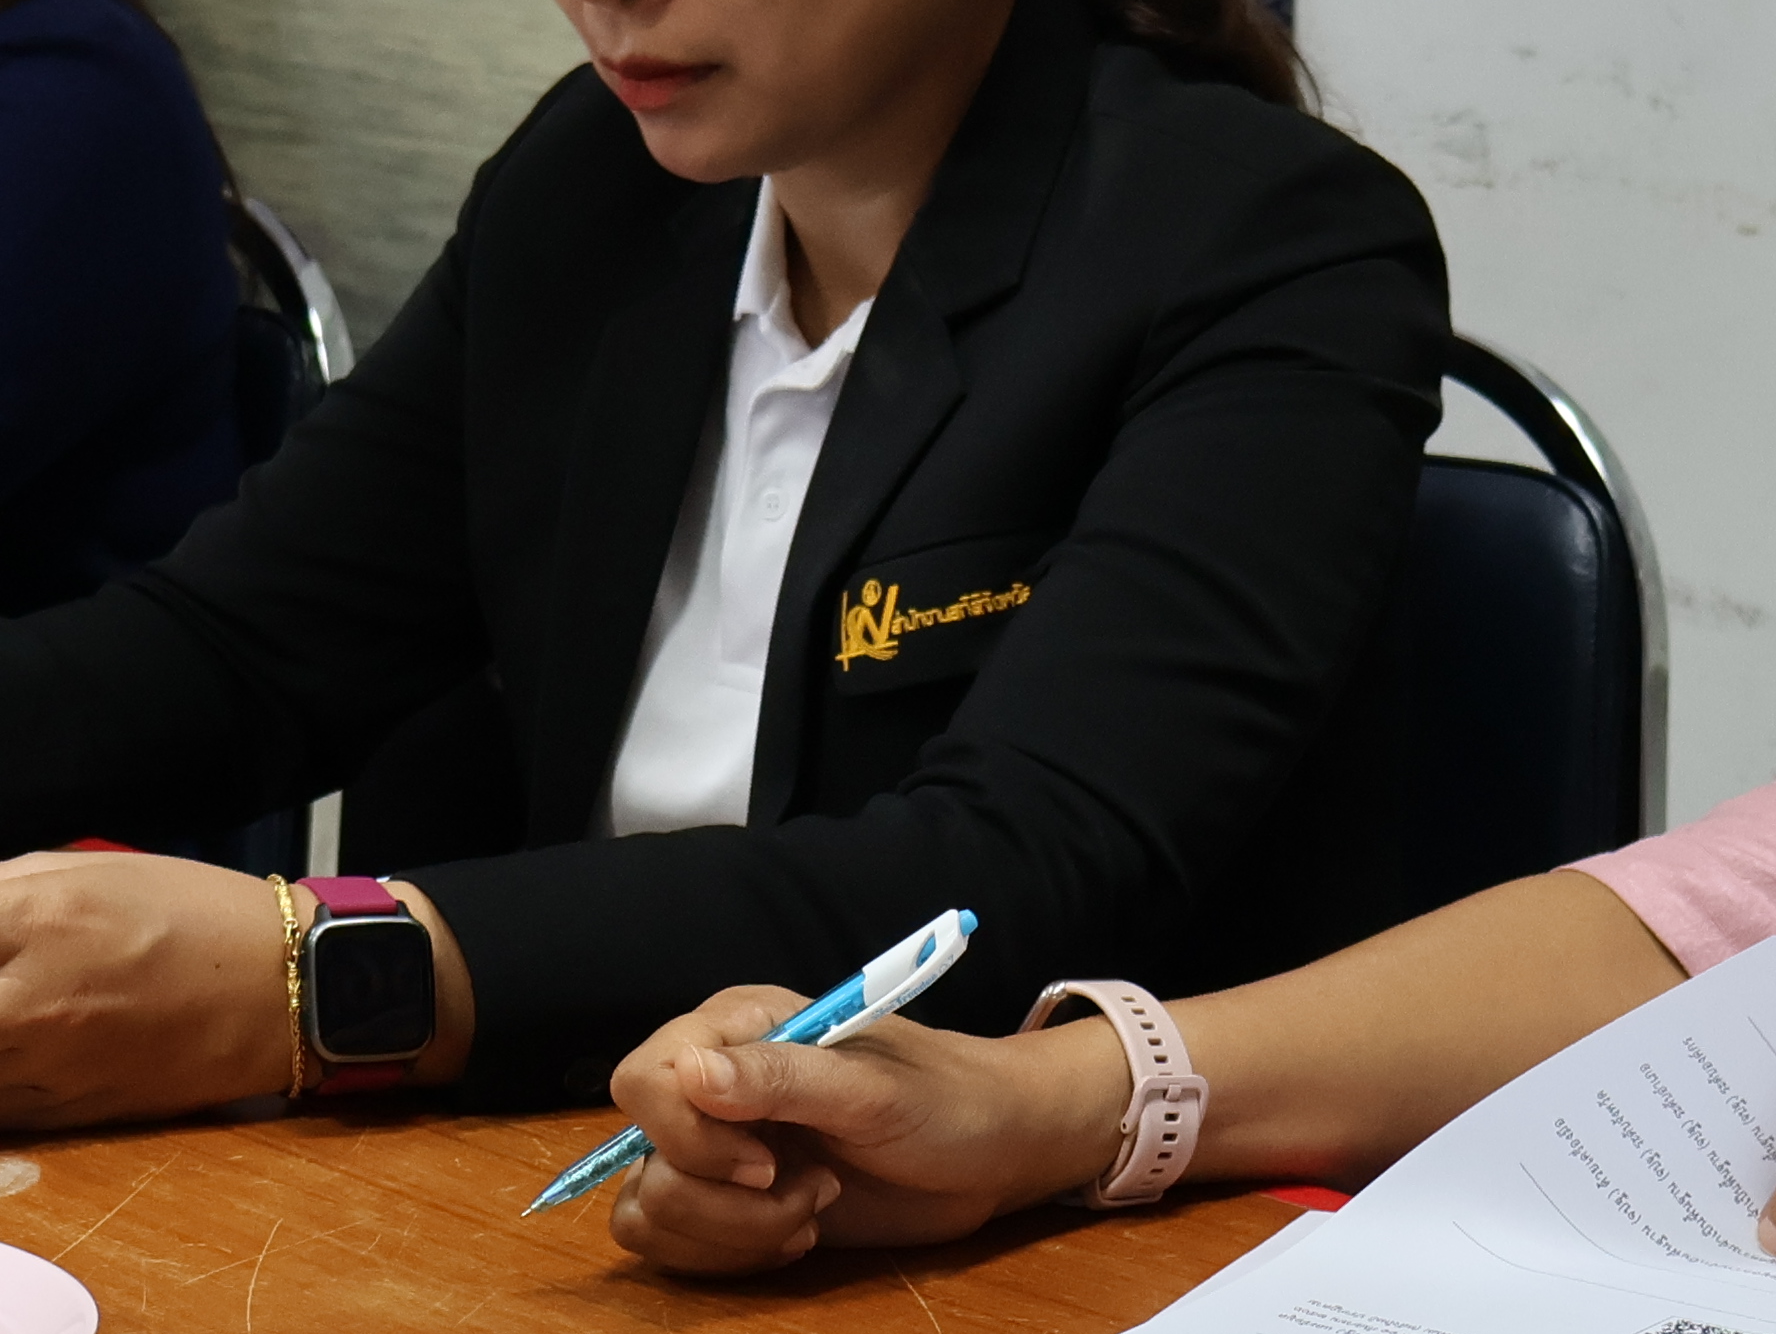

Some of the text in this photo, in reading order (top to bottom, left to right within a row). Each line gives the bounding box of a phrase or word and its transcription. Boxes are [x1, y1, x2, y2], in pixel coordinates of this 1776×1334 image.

[1680, 1035, 1730, 1097] ระดับองค์กร
[1594, 1088, 1645, 1150] ระดับจังหวัด
[1637, 1060, 1761, 1220] จำเป็นพื้นฐาน (จปฐ.) ระดับอำเภอ
[1725, 1093, 1755, 1128] (จปฐ.)
[1552, 1117, 1612, 1189] ด้วยเครื่องมือ
[1637, 1146, 1669, 1183] (จปฐ.)
[1606, 1187, 1642, 1225] (จปฐ.)
